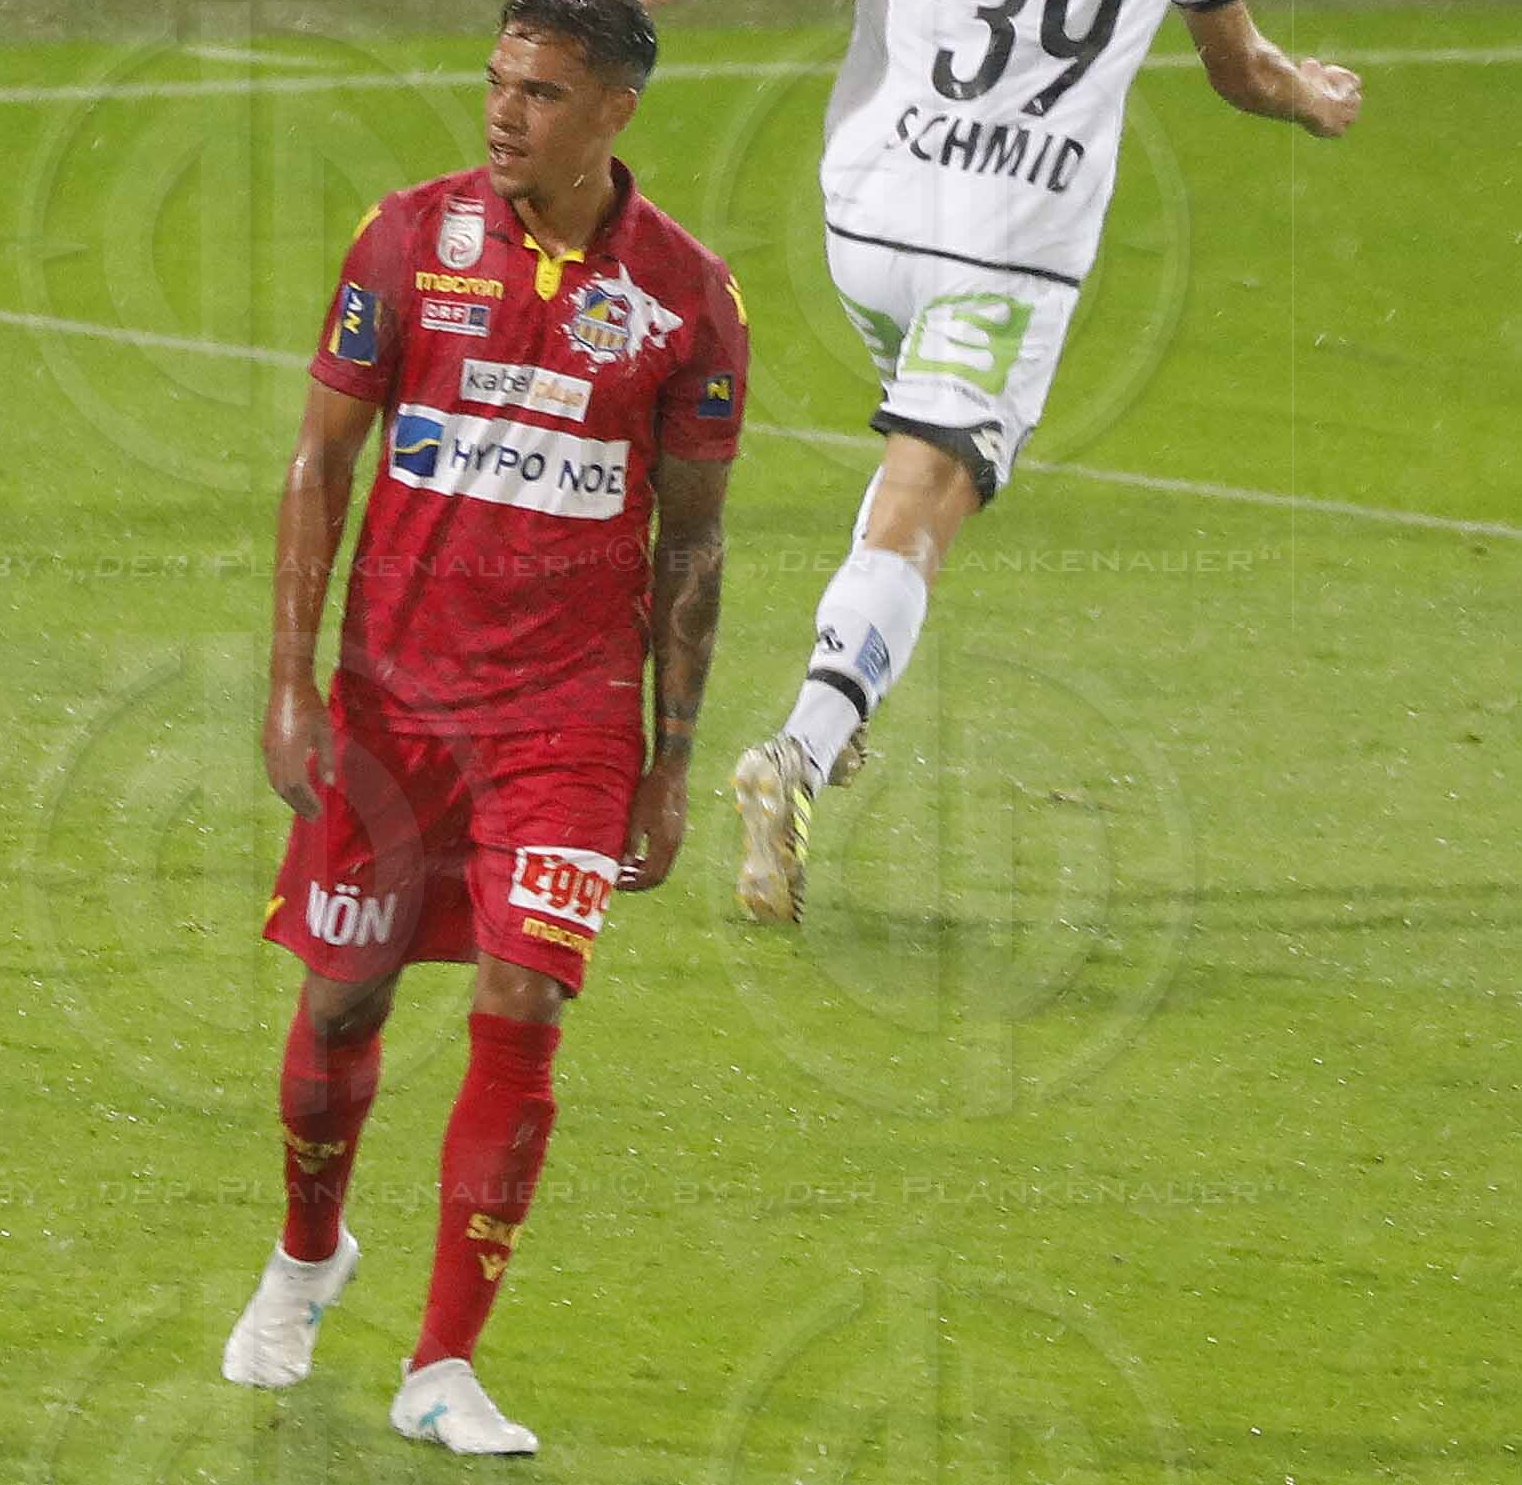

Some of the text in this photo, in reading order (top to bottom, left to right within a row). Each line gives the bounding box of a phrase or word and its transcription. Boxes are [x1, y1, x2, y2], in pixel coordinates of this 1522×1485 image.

[893, 105, 1085, 194] SCHMID
[451, 438, 625, 498] HYPO NOE
